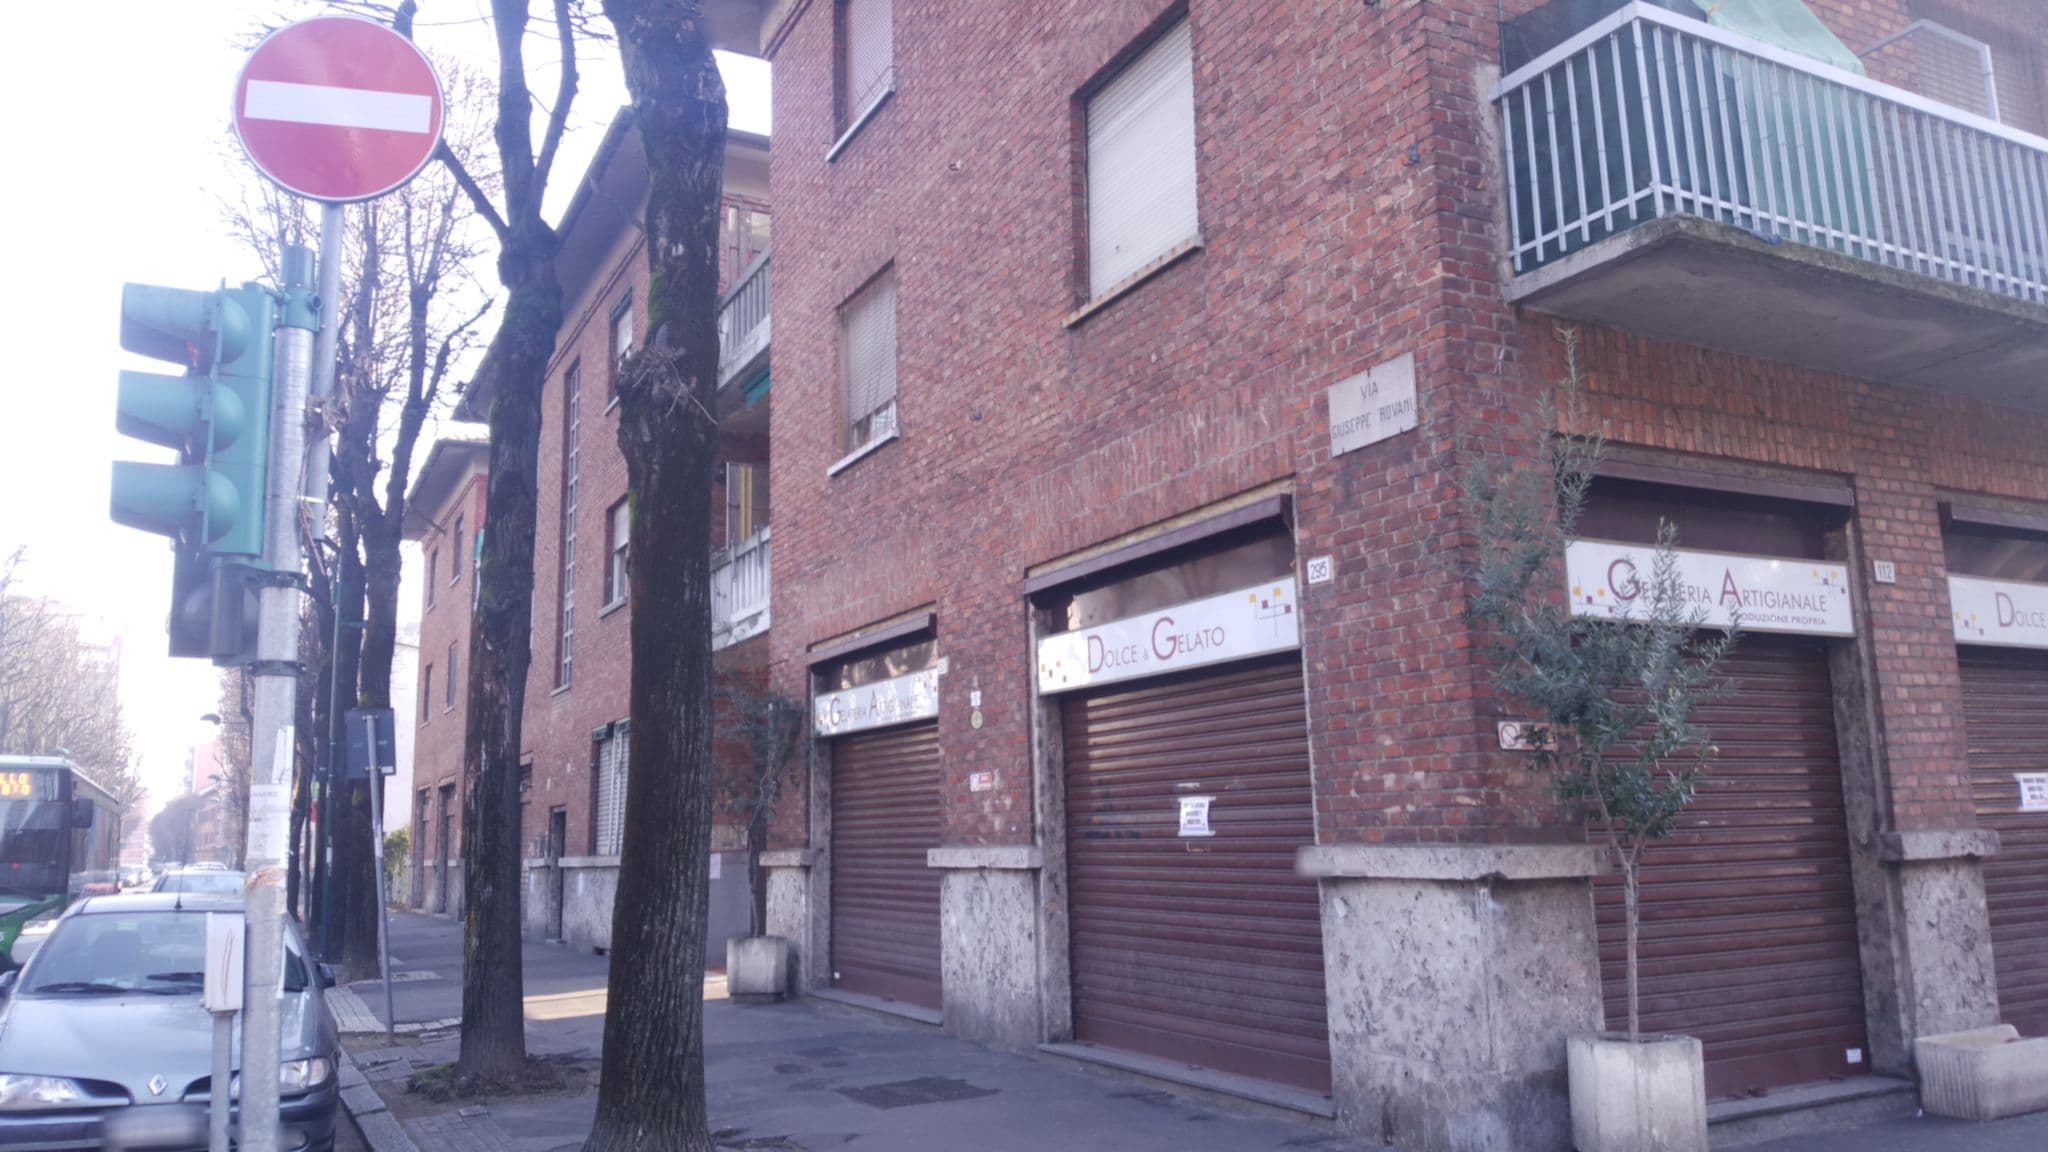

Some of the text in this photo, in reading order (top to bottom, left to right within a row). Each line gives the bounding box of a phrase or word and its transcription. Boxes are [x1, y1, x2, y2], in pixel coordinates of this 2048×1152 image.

[1360, 382, 1378, 399] VIA
[1332, 398, 1413, 439] GIUSEPPE ROVANI
[1311, 561, 1327, 579] 295
[1877, 563, 1892, 580] 112
[1607, 559, 1826, 612] GELERIA ARTIGIANALE
[1733, 611, 1788, 624] ODUZIONE
[1995, 592, 2047, 628] DOLCE
[1088, 634, 1137, 674] DOLCE
[1152, 616, 1225, 660] GELATO
